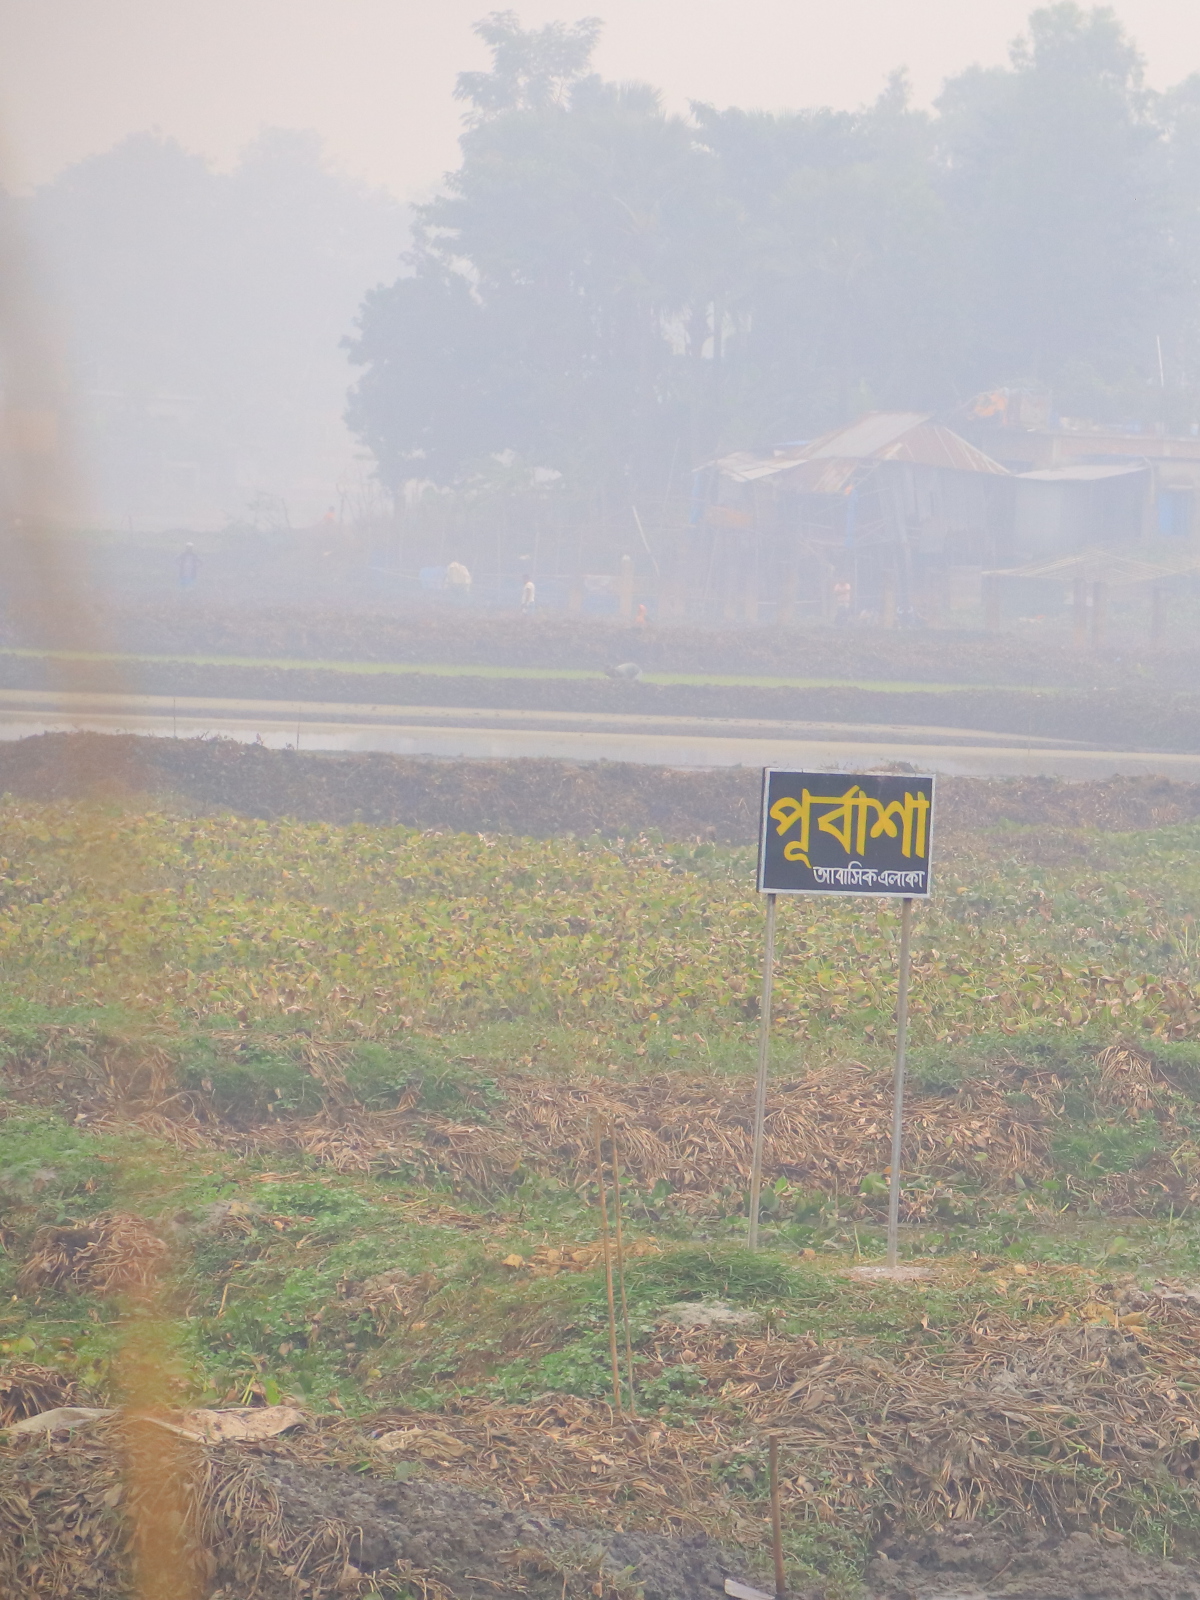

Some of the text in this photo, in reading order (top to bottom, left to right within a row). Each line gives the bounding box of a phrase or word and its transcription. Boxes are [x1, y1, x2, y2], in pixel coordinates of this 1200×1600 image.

[769, 784, 930, 869] পূর্বাশা
[812, 860, 926, 888] আবাসিক এলাকা
